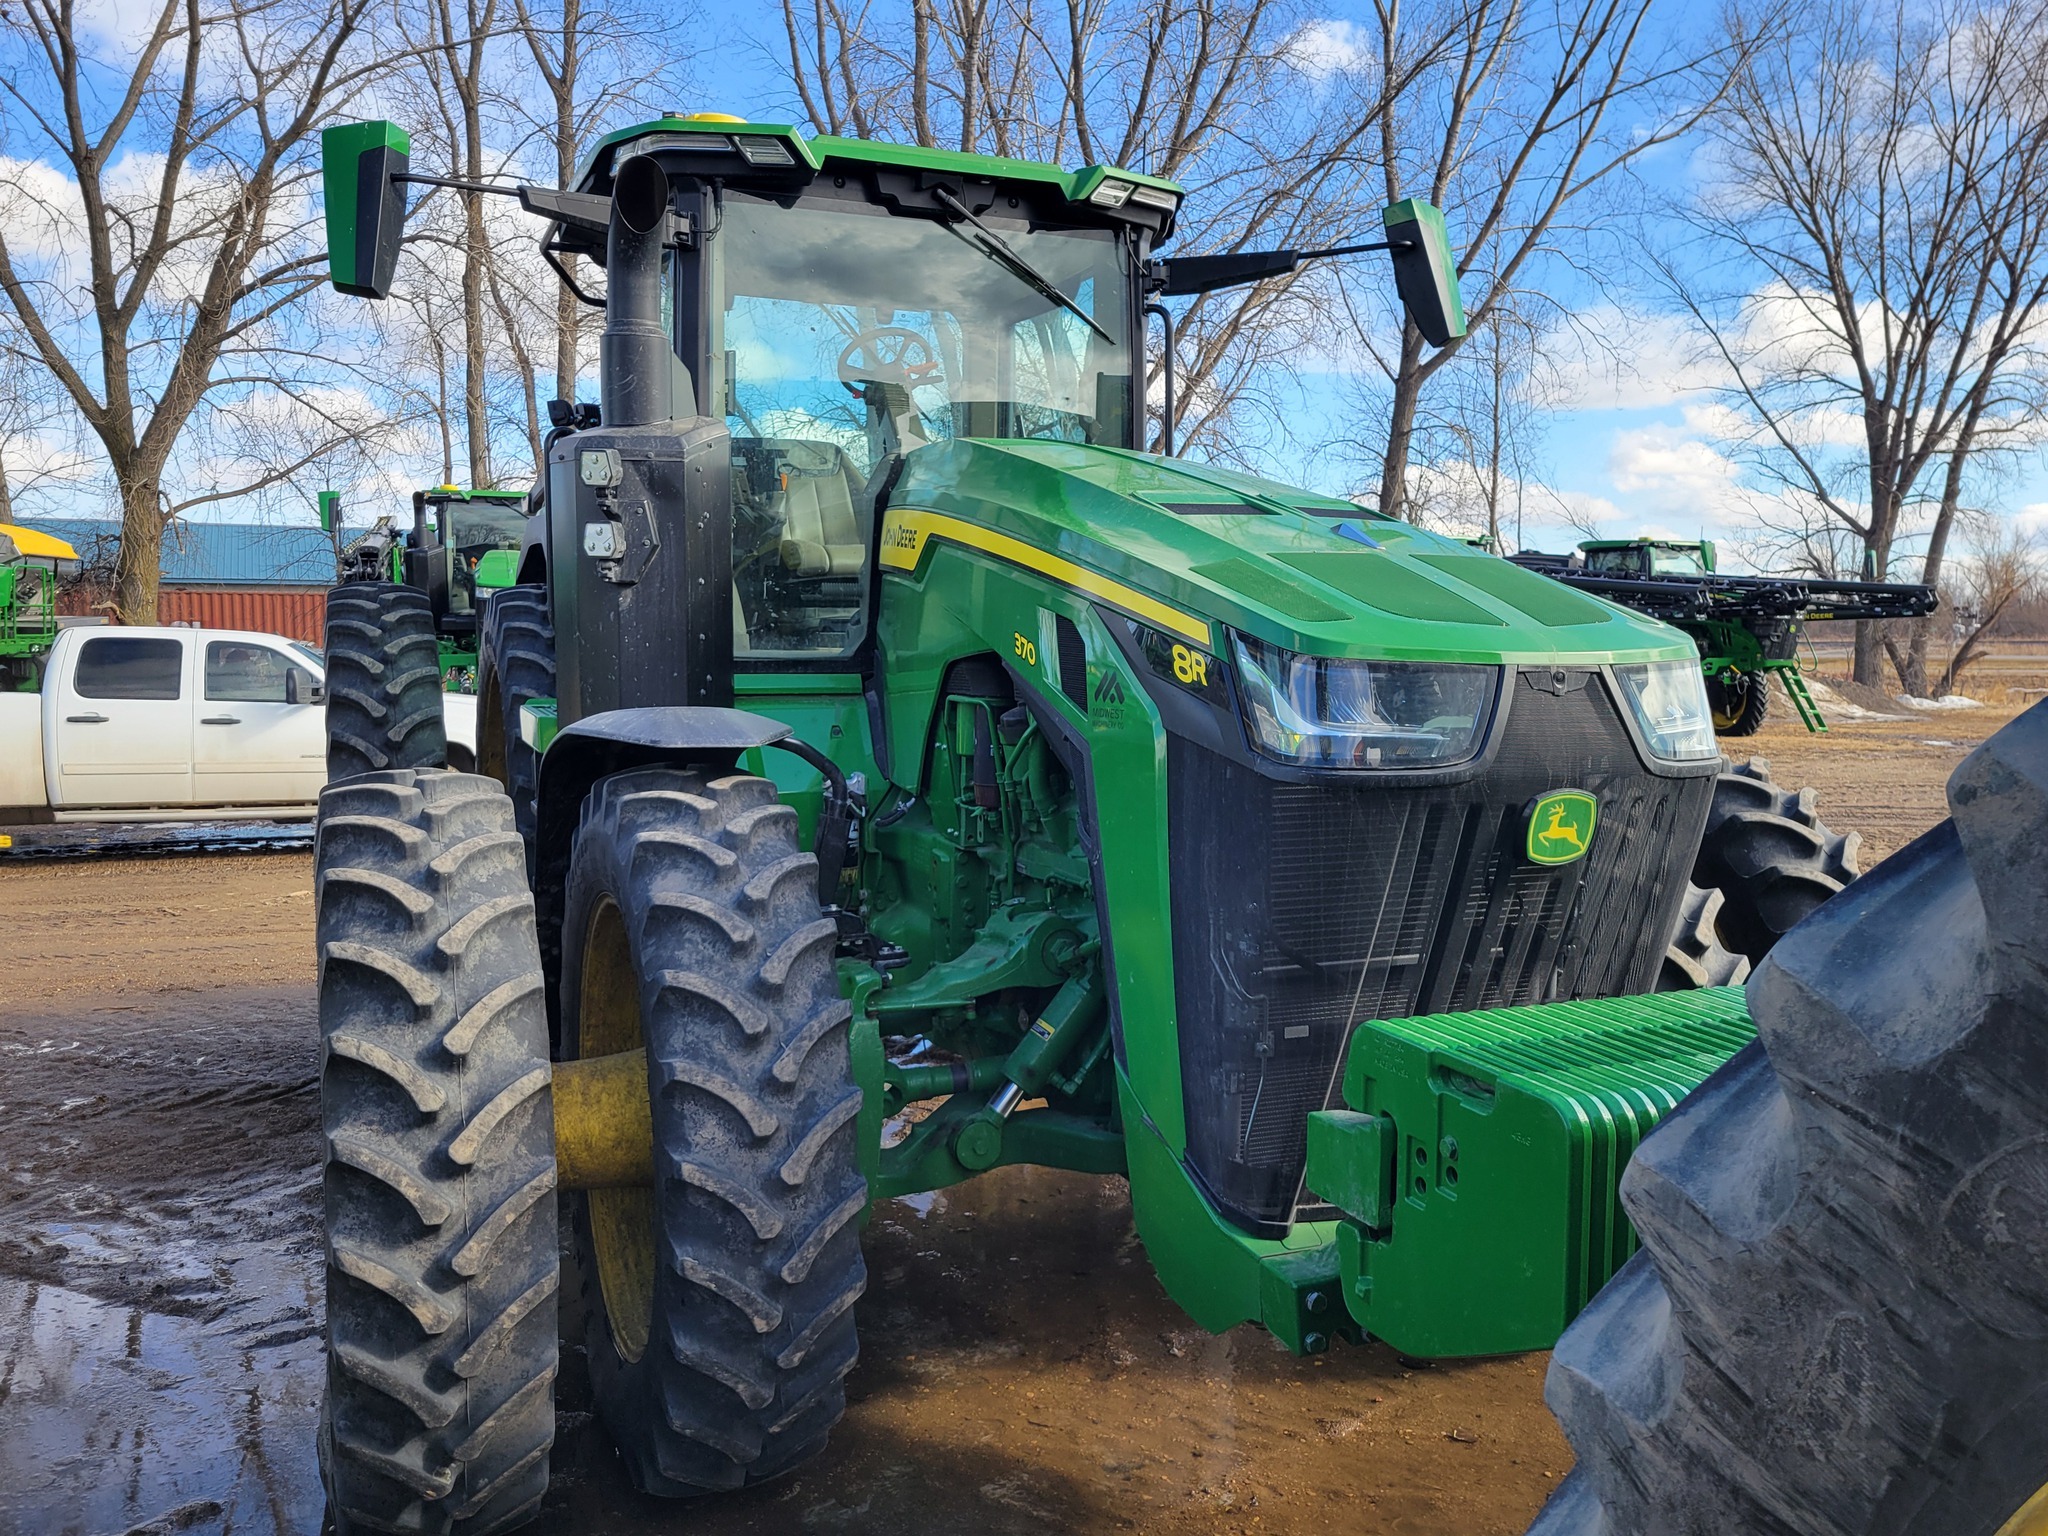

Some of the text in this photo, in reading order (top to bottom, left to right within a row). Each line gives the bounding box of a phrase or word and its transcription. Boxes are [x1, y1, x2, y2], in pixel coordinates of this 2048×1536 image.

[884, 524, 917, 549] JOHN DEERE
[1014, 631, 1036, 666] 370
[1172, 644, 1208, 687] 8R
[1093, 708, 1125, 720] MIDWEST
